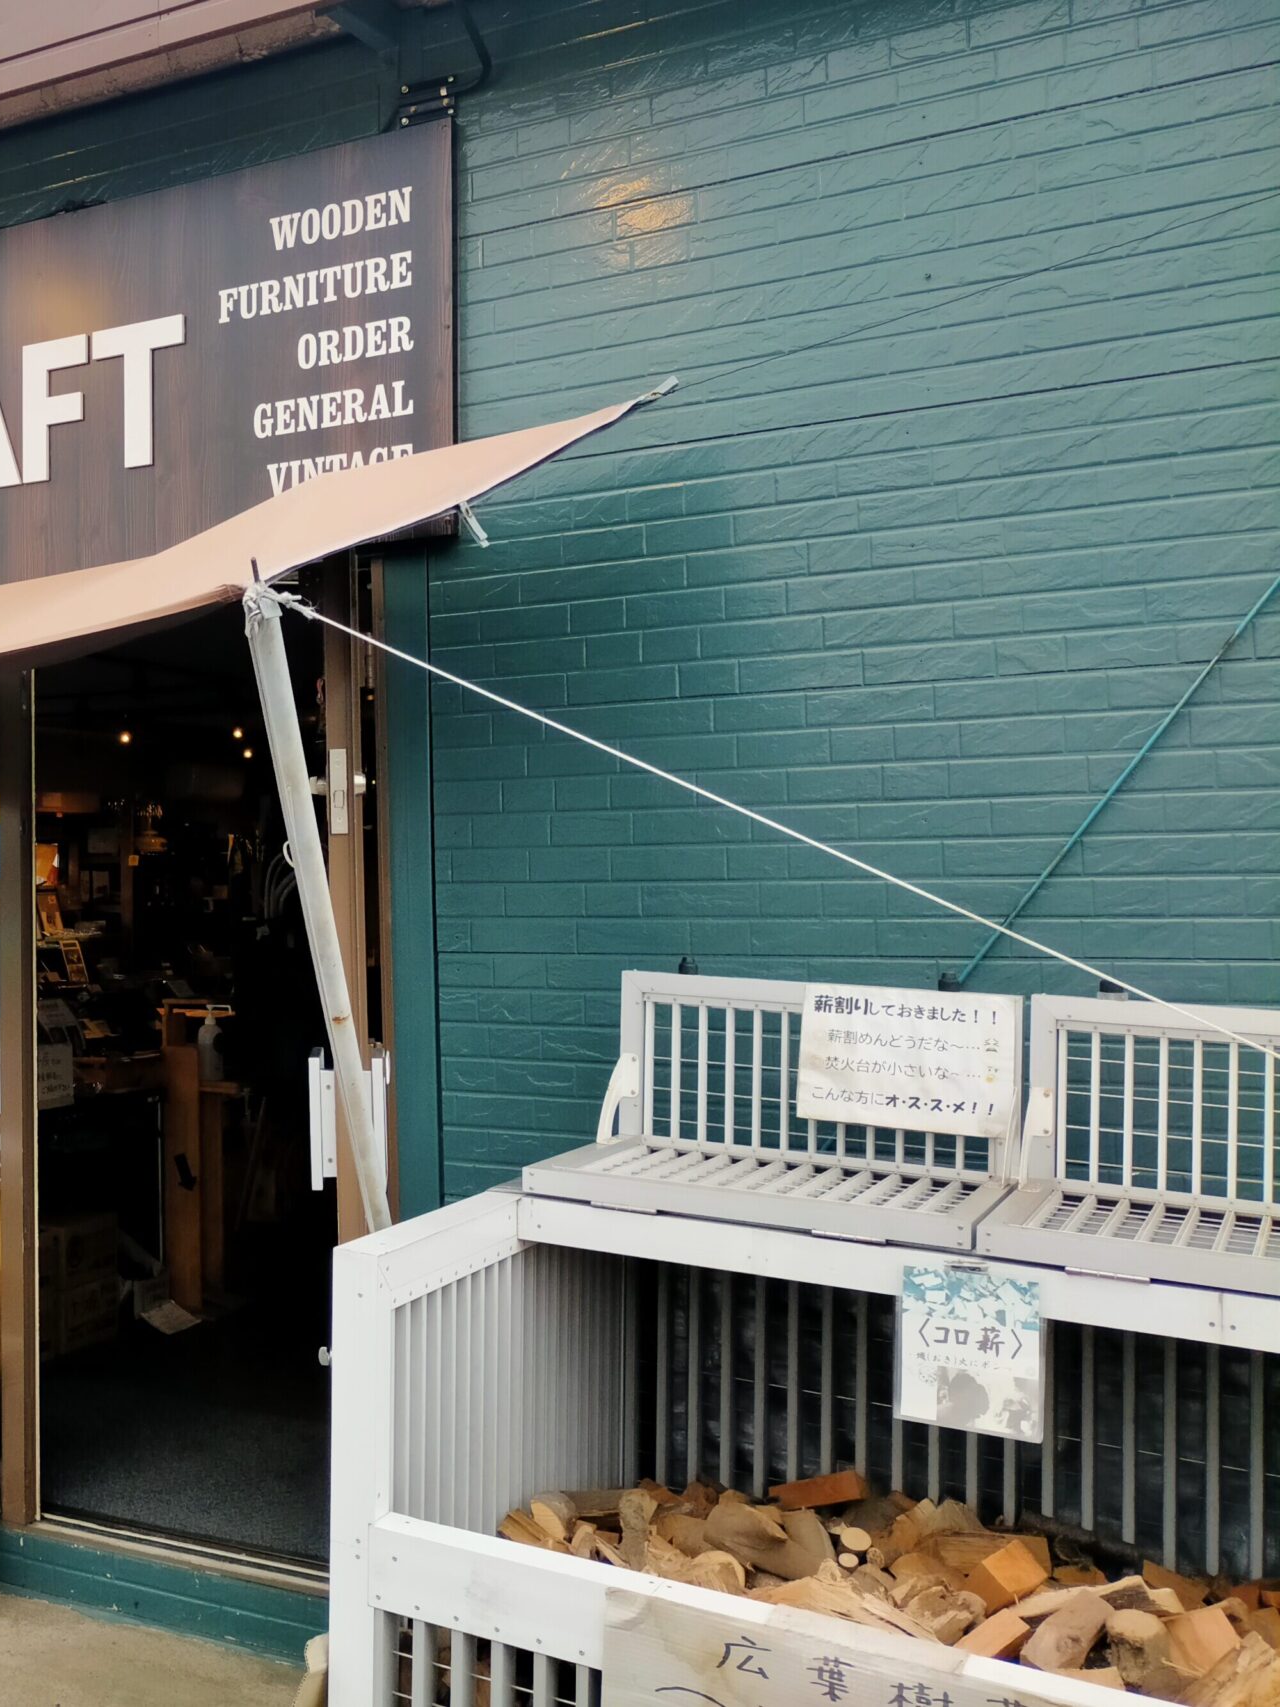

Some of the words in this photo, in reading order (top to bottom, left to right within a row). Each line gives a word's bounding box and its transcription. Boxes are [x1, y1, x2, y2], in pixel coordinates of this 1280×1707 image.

[269, 186, 412, 251] WOODEN
[218, 250, 412, 324] FURNITURE
[297, 316, 414, 370] ORDER
[253, 380, 414, 439] GENERAL
[814, 995, 997, 1024] 薪割りしておきました！！
[717, 1636, 1024, 1707] 広葉樹
